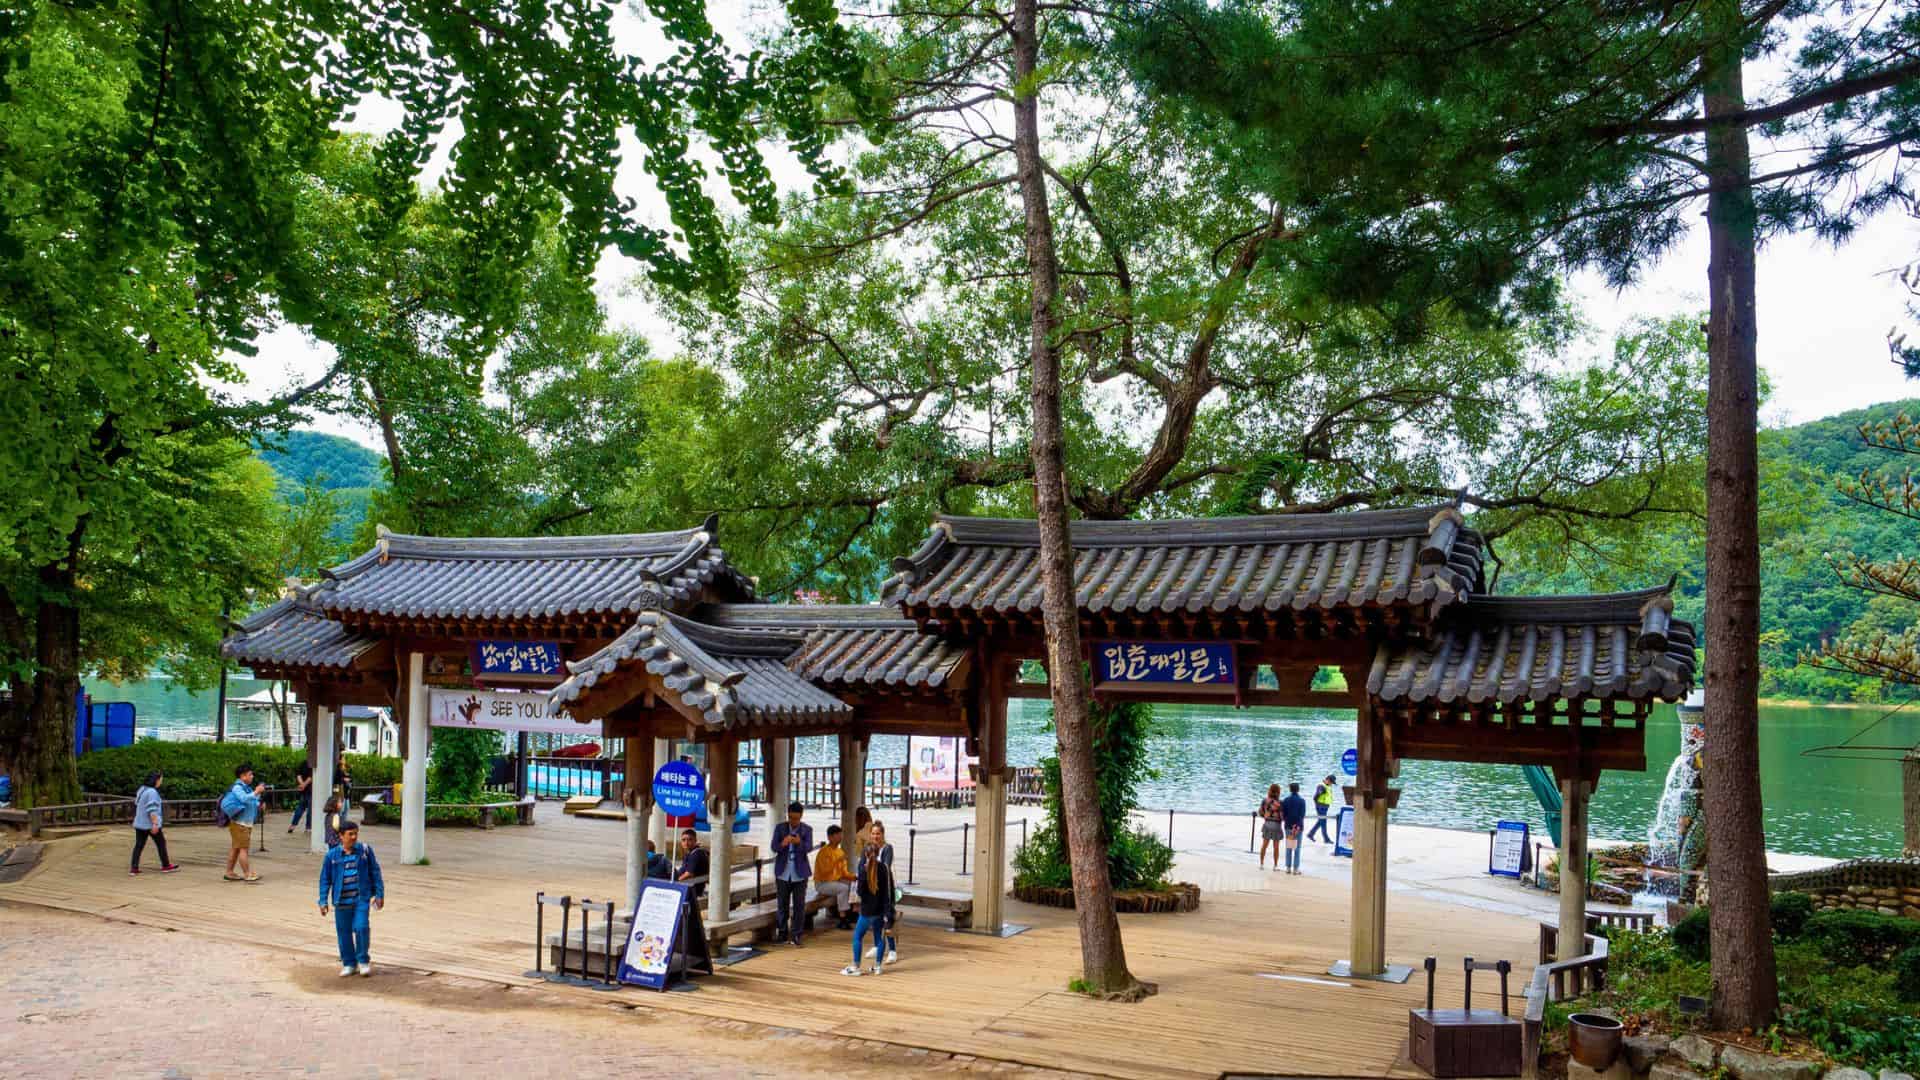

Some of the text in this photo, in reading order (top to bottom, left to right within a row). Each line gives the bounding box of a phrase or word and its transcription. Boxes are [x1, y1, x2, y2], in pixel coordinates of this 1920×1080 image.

[1104, 645, 1215, 683] 입춘대길문
[490, 700, 513, 717] SEE
[517, 702, 543, 719] YOU
[661, 771, 687, 785] 배타는
[657, 786, 699, 800] Line for Ferry
